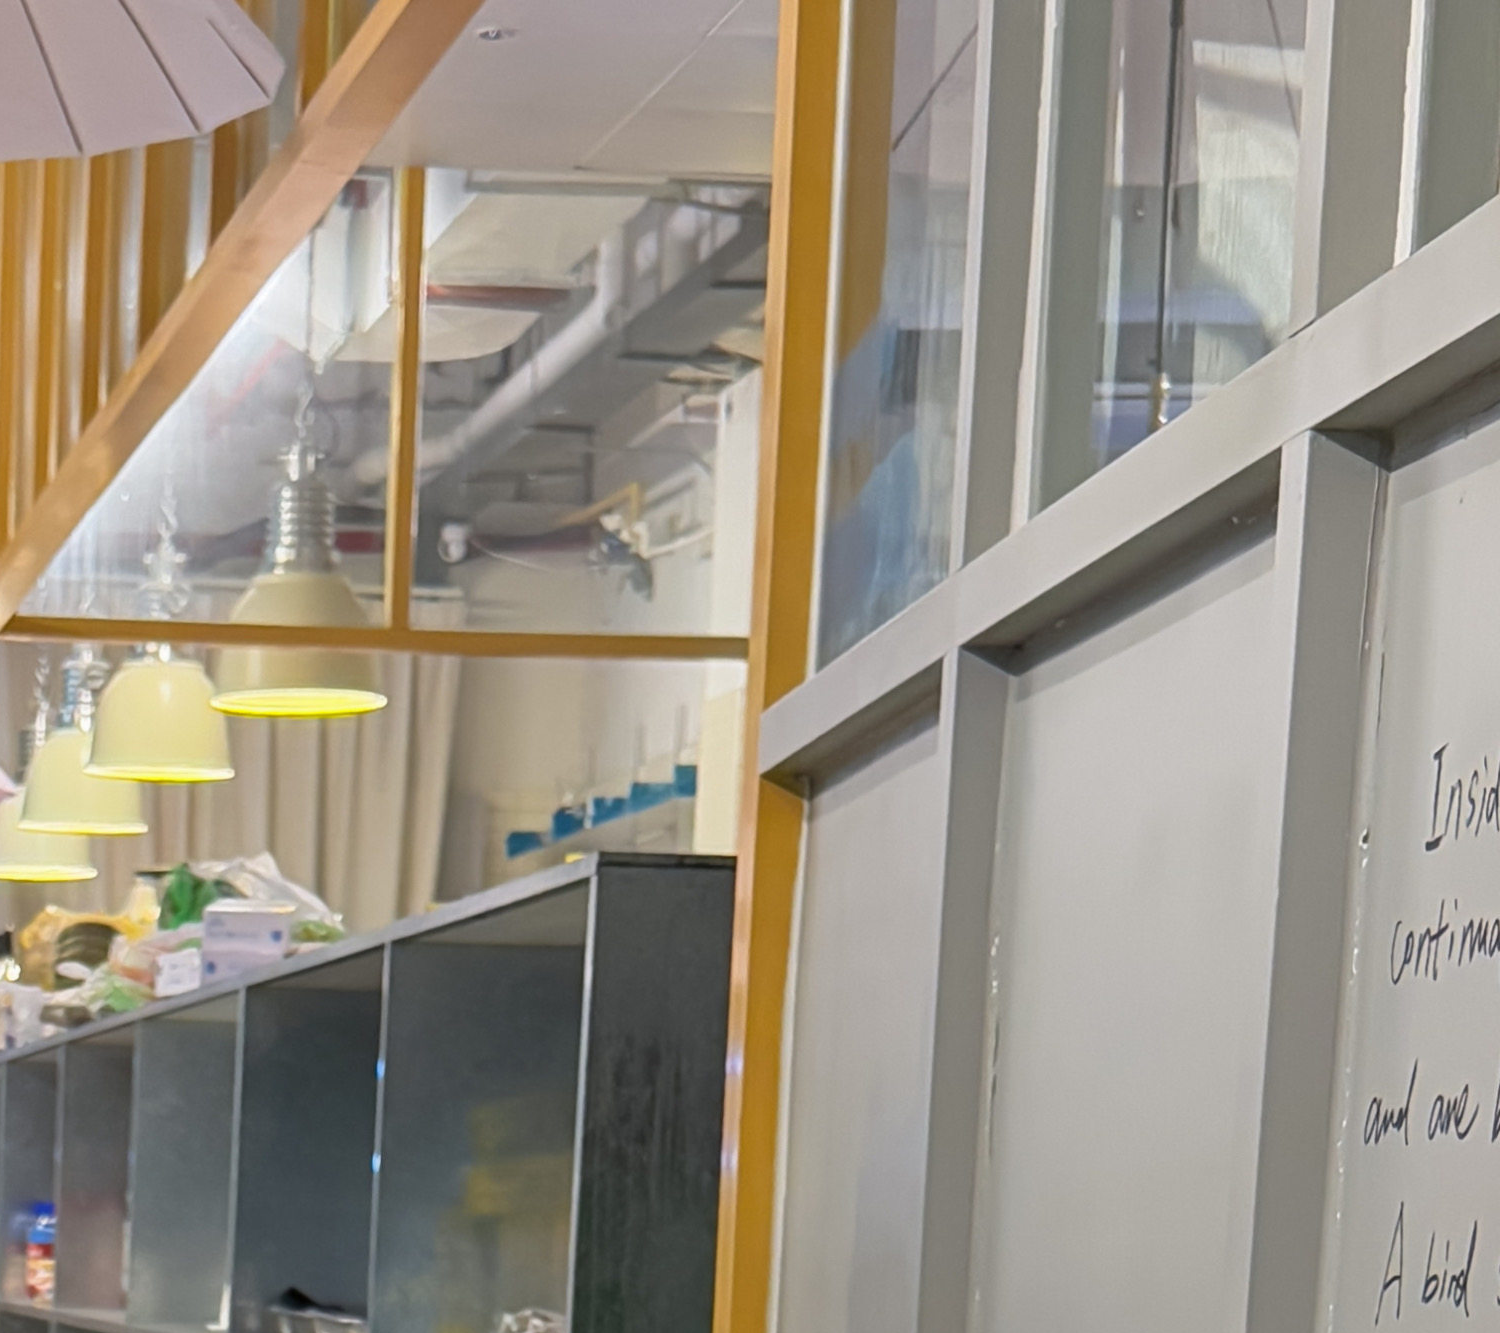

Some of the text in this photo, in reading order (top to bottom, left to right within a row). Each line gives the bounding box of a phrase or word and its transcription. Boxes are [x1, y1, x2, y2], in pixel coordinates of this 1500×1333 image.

[1364, 1057, 1418, 1146] and
[1375, 1200, 1477, 1327] A bird
